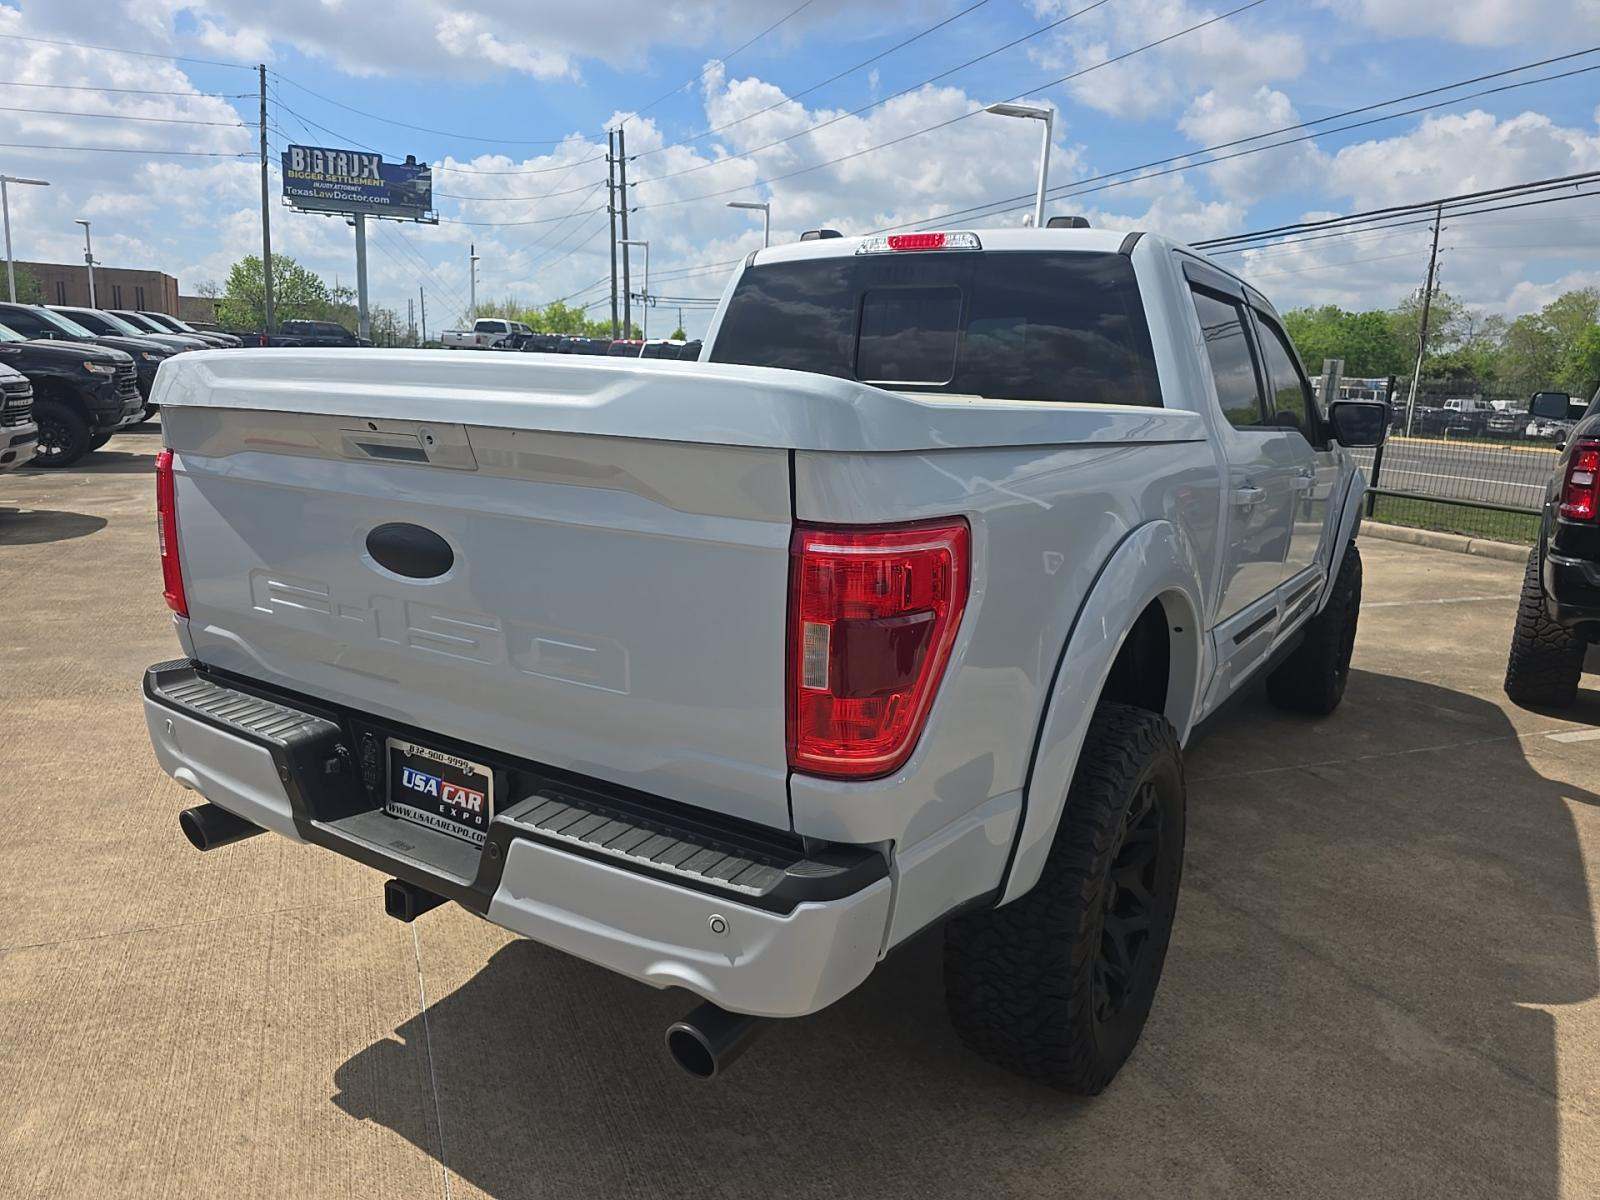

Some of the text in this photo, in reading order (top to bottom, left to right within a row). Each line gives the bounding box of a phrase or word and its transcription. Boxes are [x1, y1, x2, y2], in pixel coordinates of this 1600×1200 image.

[288, 169, 386, 187] BIGGER SETTLEMENT
[286, 186, 390, 204] TexasLawDoctor.com
[249, 568, 631, 695] F-150
[408, 744, 469, 768] 832-900-9999
[402, 769, 482, 812] USA CAR
[440, 804, 482, 824] EXPO
